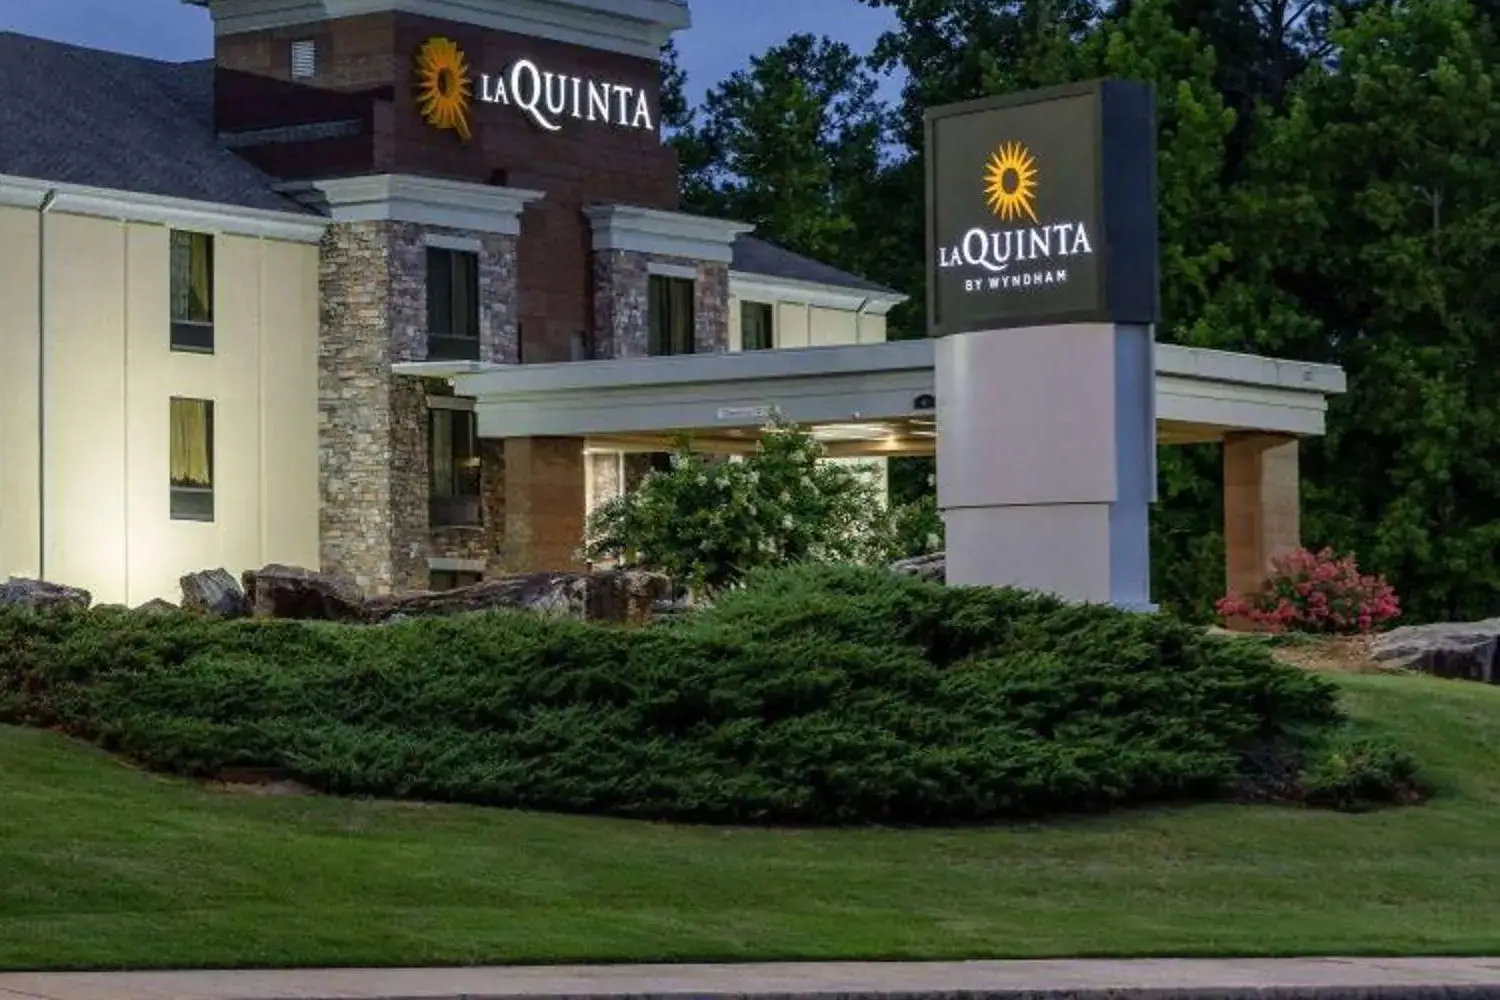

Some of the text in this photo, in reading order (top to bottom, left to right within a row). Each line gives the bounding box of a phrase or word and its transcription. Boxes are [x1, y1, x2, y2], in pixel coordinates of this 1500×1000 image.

[481, 59, 654, 130] LA QUINTA
[938, 221, 1093, 271] LA QUINTA
[964, 270, 1067, 292] BY WYNDHAM
